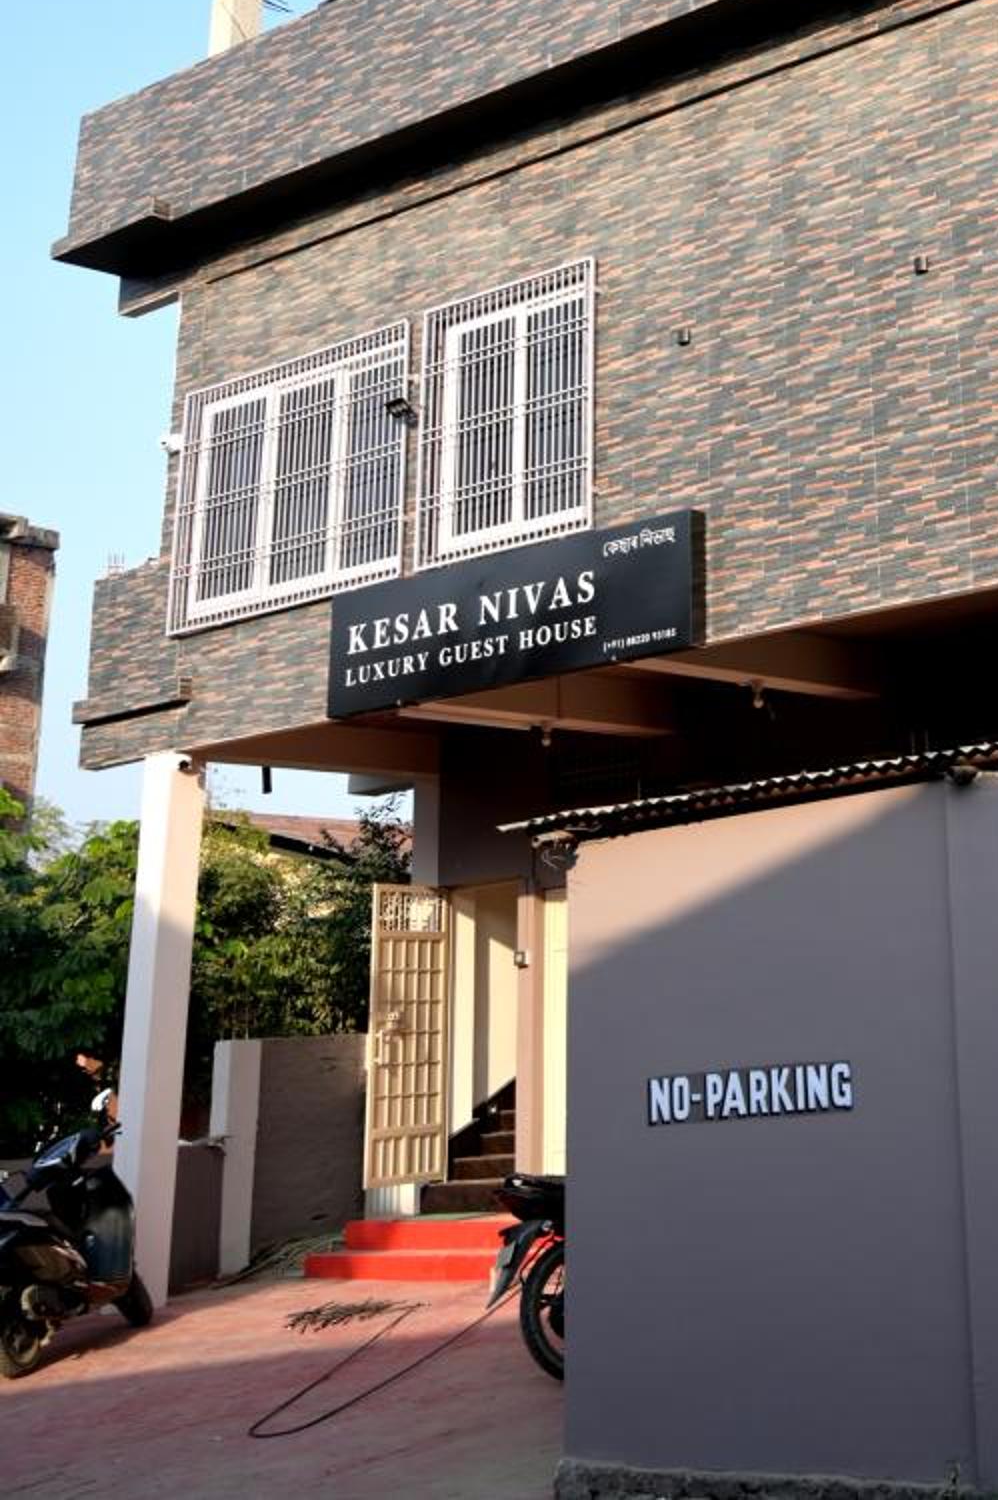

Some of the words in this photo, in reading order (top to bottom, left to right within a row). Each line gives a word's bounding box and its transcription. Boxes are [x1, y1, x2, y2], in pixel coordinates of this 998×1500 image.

[346, 602, 459, 655] KESAR
[478, 570, 595, 625] NIVAS
[345, 652, 429, 687] LUXURY
[438, 634, 509, 666] GUEST
[519, 615, 597, 650] HOUSE
[649, 1061, 853, 1124] NO-PARKING
